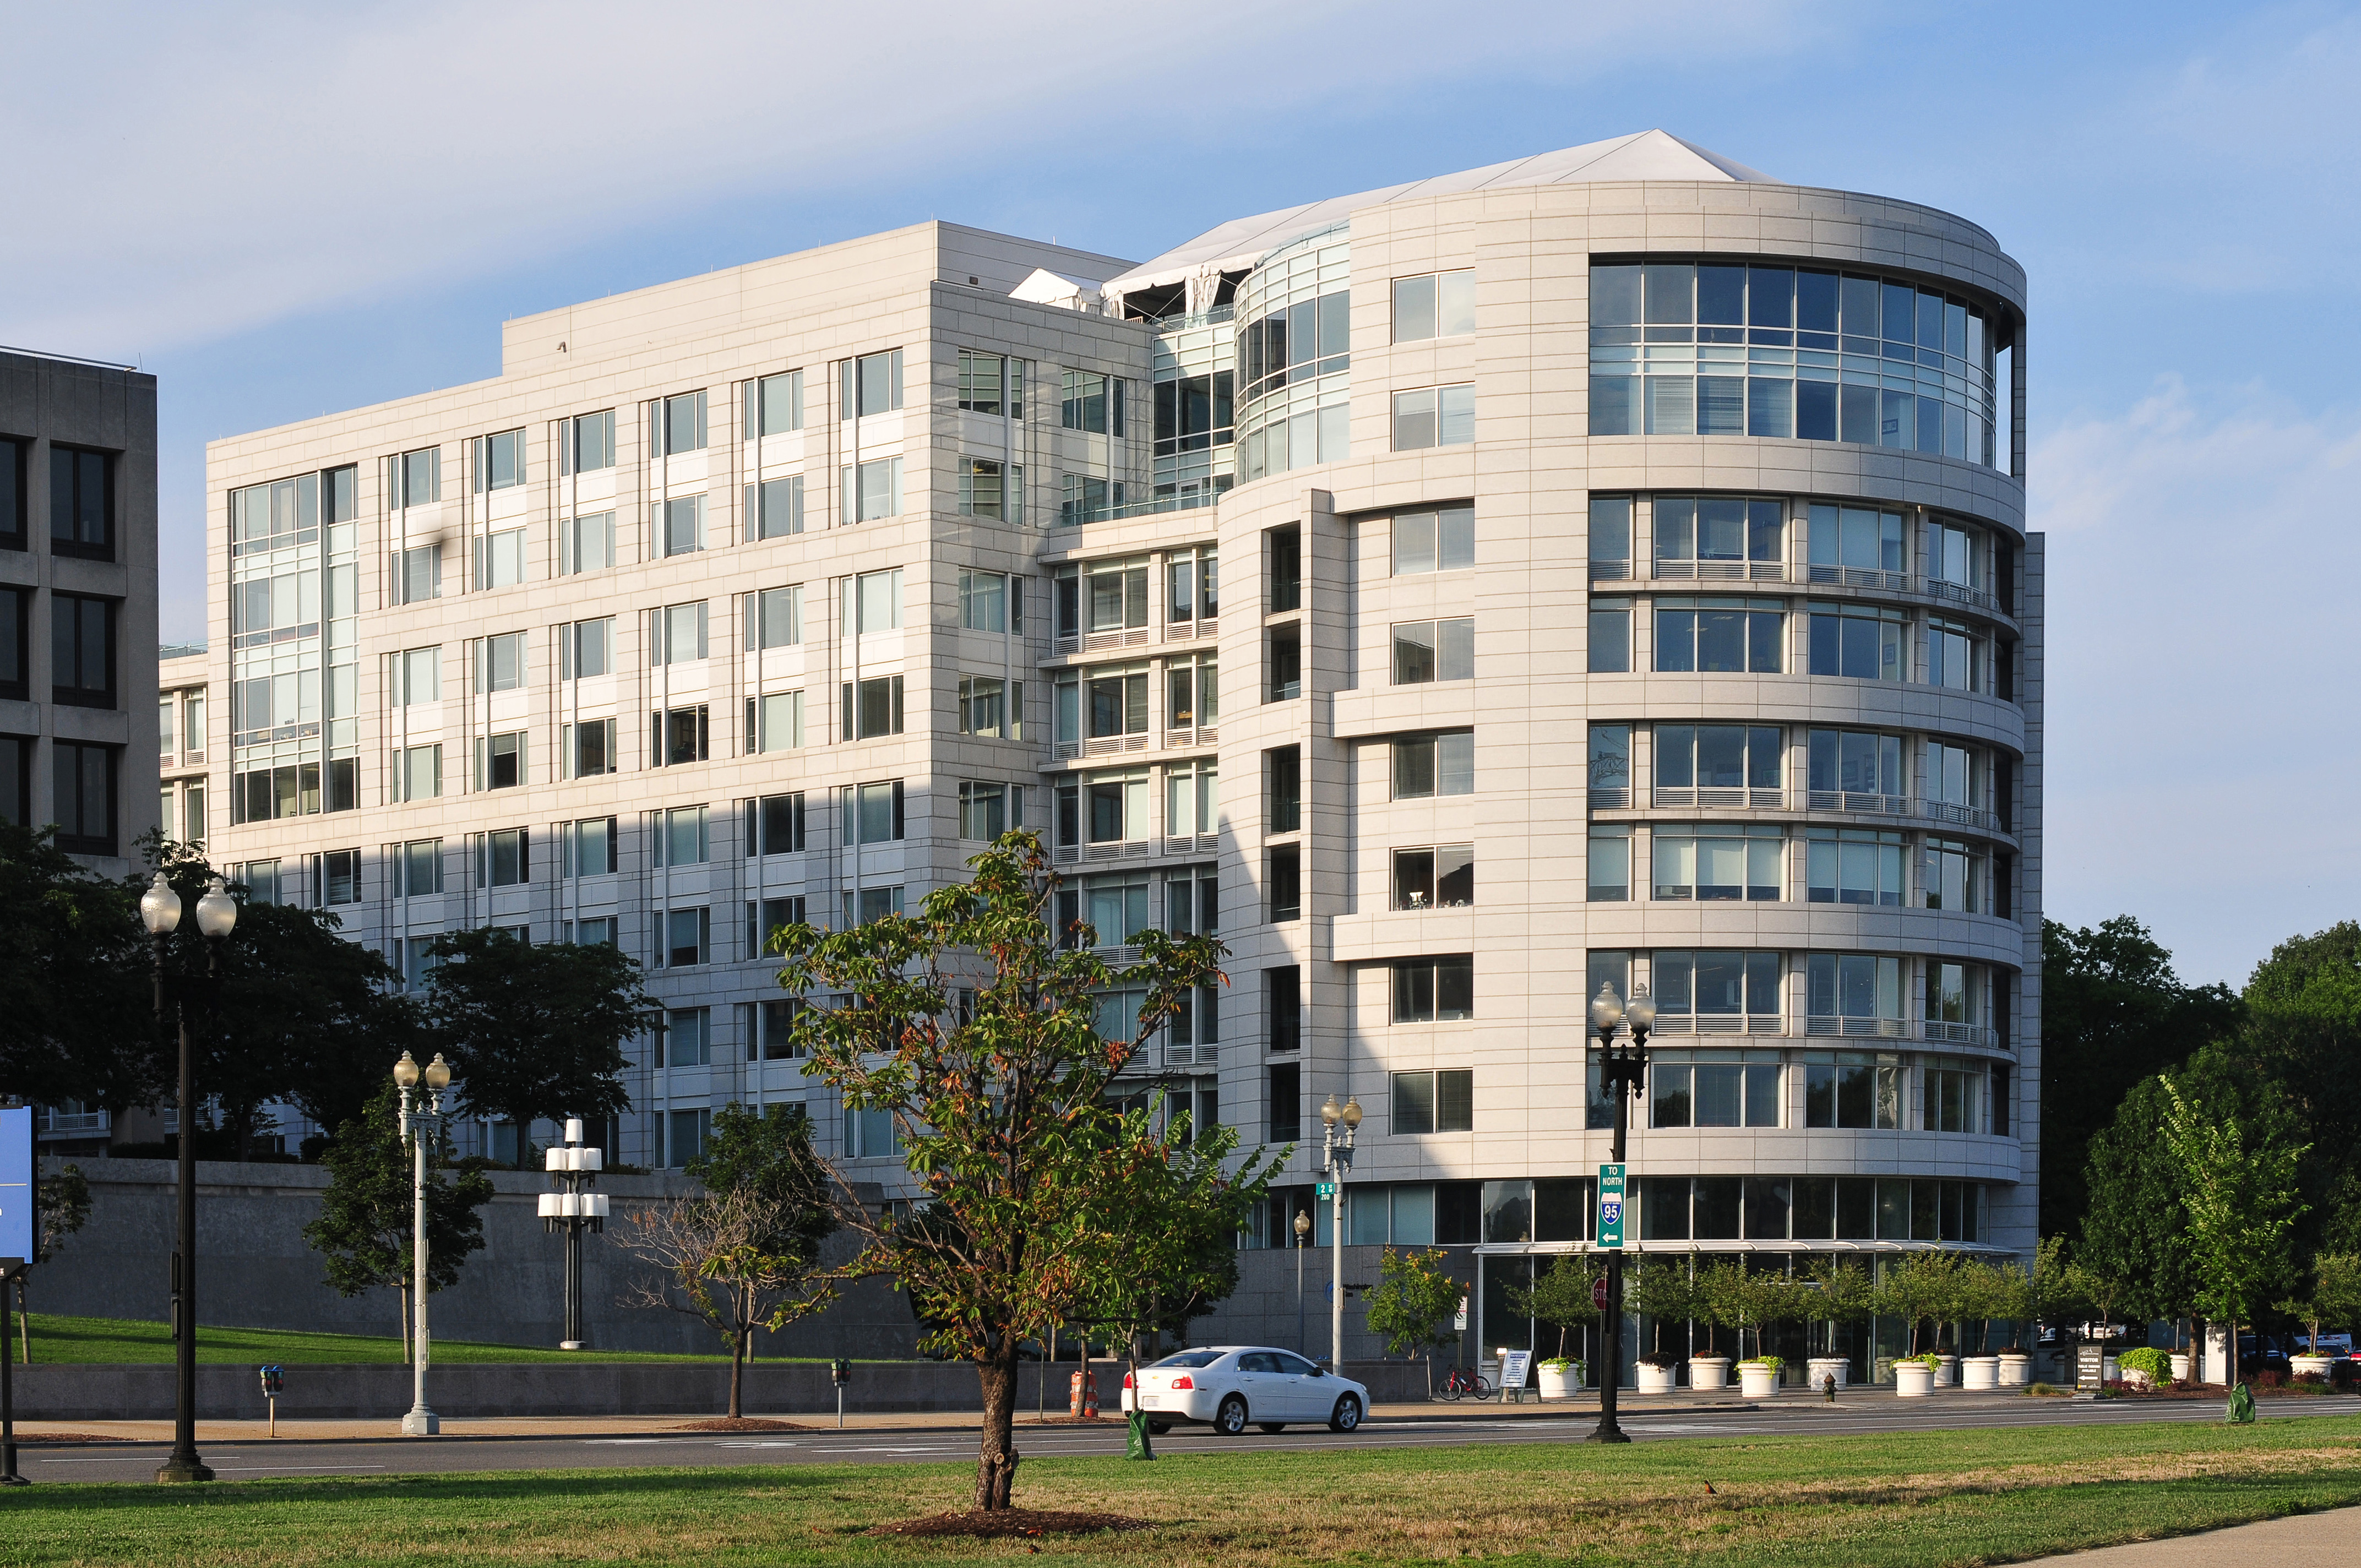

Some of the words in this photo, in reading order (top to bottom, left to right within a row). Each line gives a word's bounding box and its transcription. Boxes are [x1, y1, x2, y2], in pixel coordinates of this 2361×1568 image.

[1608, 1167, 1618, 1175] TO
[1603, 1177, 1622, 1185] NORTH
[1321, 1184, 1325, 1193] 2
[1604, 1205, 1618, 1218] 95
[1595, 1288, 1607, 1300] STO
